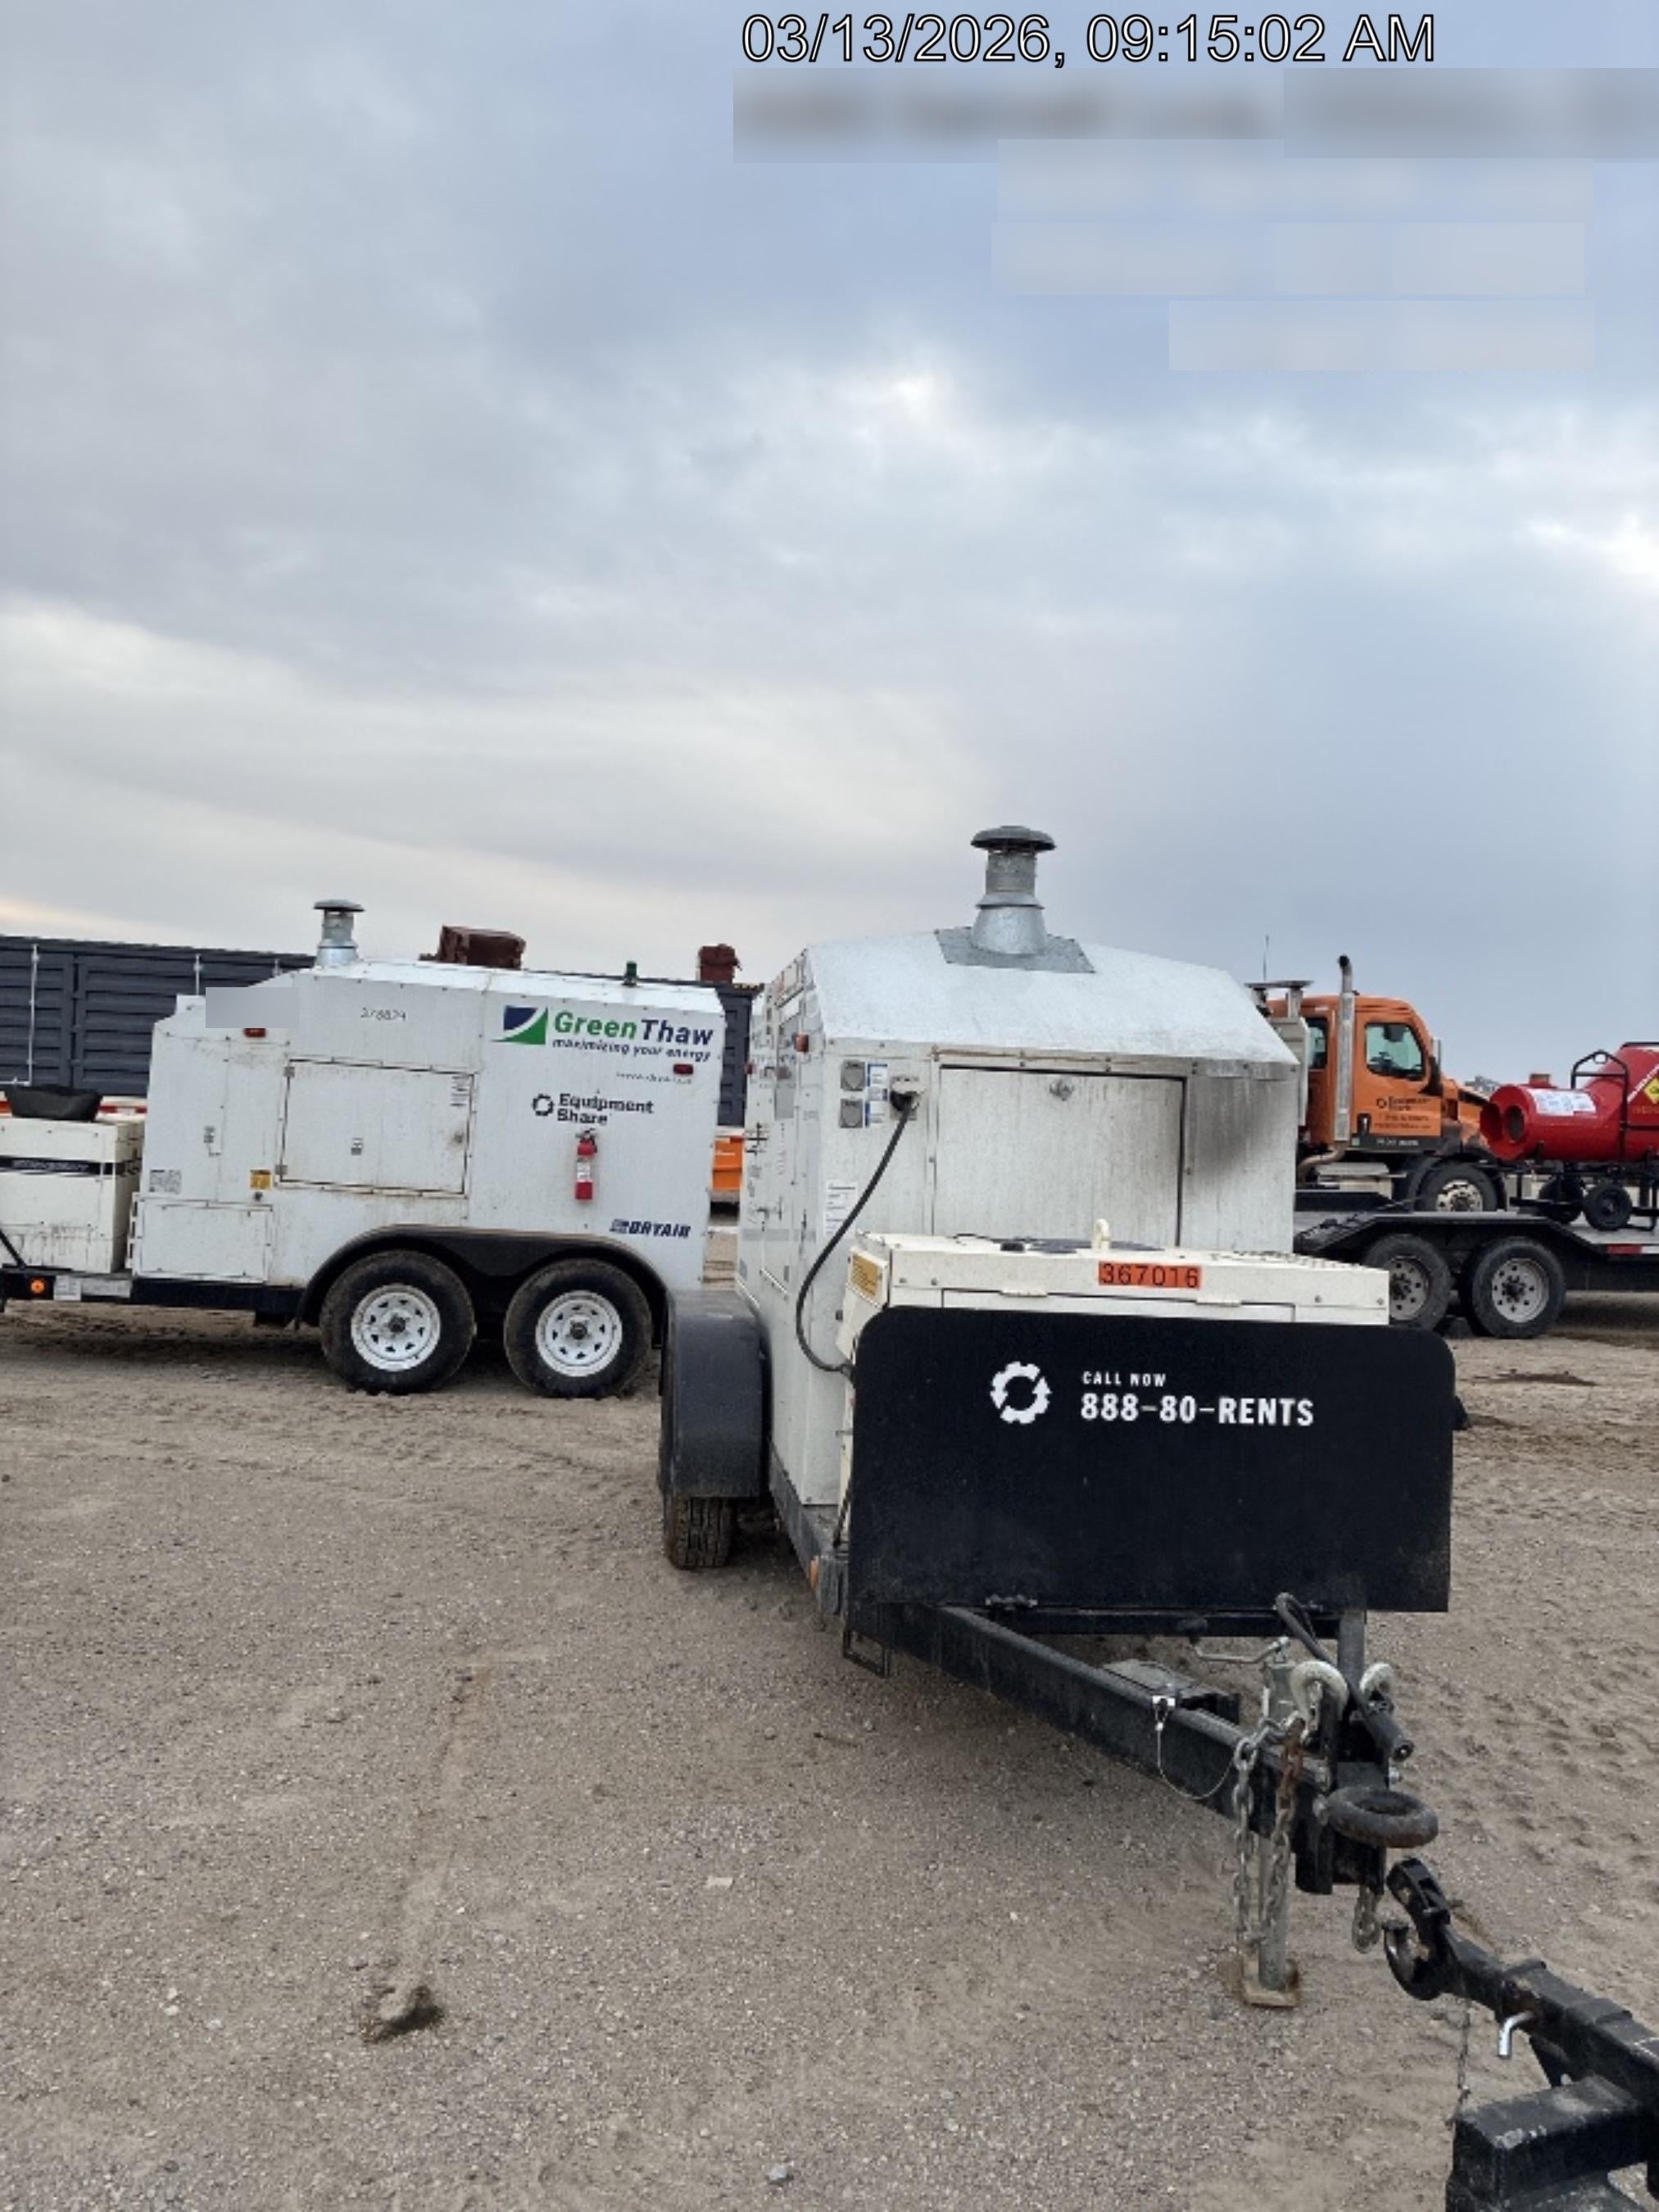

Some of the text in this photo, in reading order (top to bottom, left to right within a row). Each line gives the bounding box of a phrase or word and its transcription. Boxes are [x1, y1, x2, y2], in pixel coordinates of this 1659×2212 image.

[632, 1045, 663, 1057] your
[665, 1049, 711, 1063] energy
[559, 1093, 655, 1113] Equipment
[556, 1108, 608, 1125] Share
[1103, 1262, 1199, 1288] 367016
[1081, 1371, 1167, 1387] CALL NOW
[1081, 1393, 1314, 1427] 888-80-RENTS
